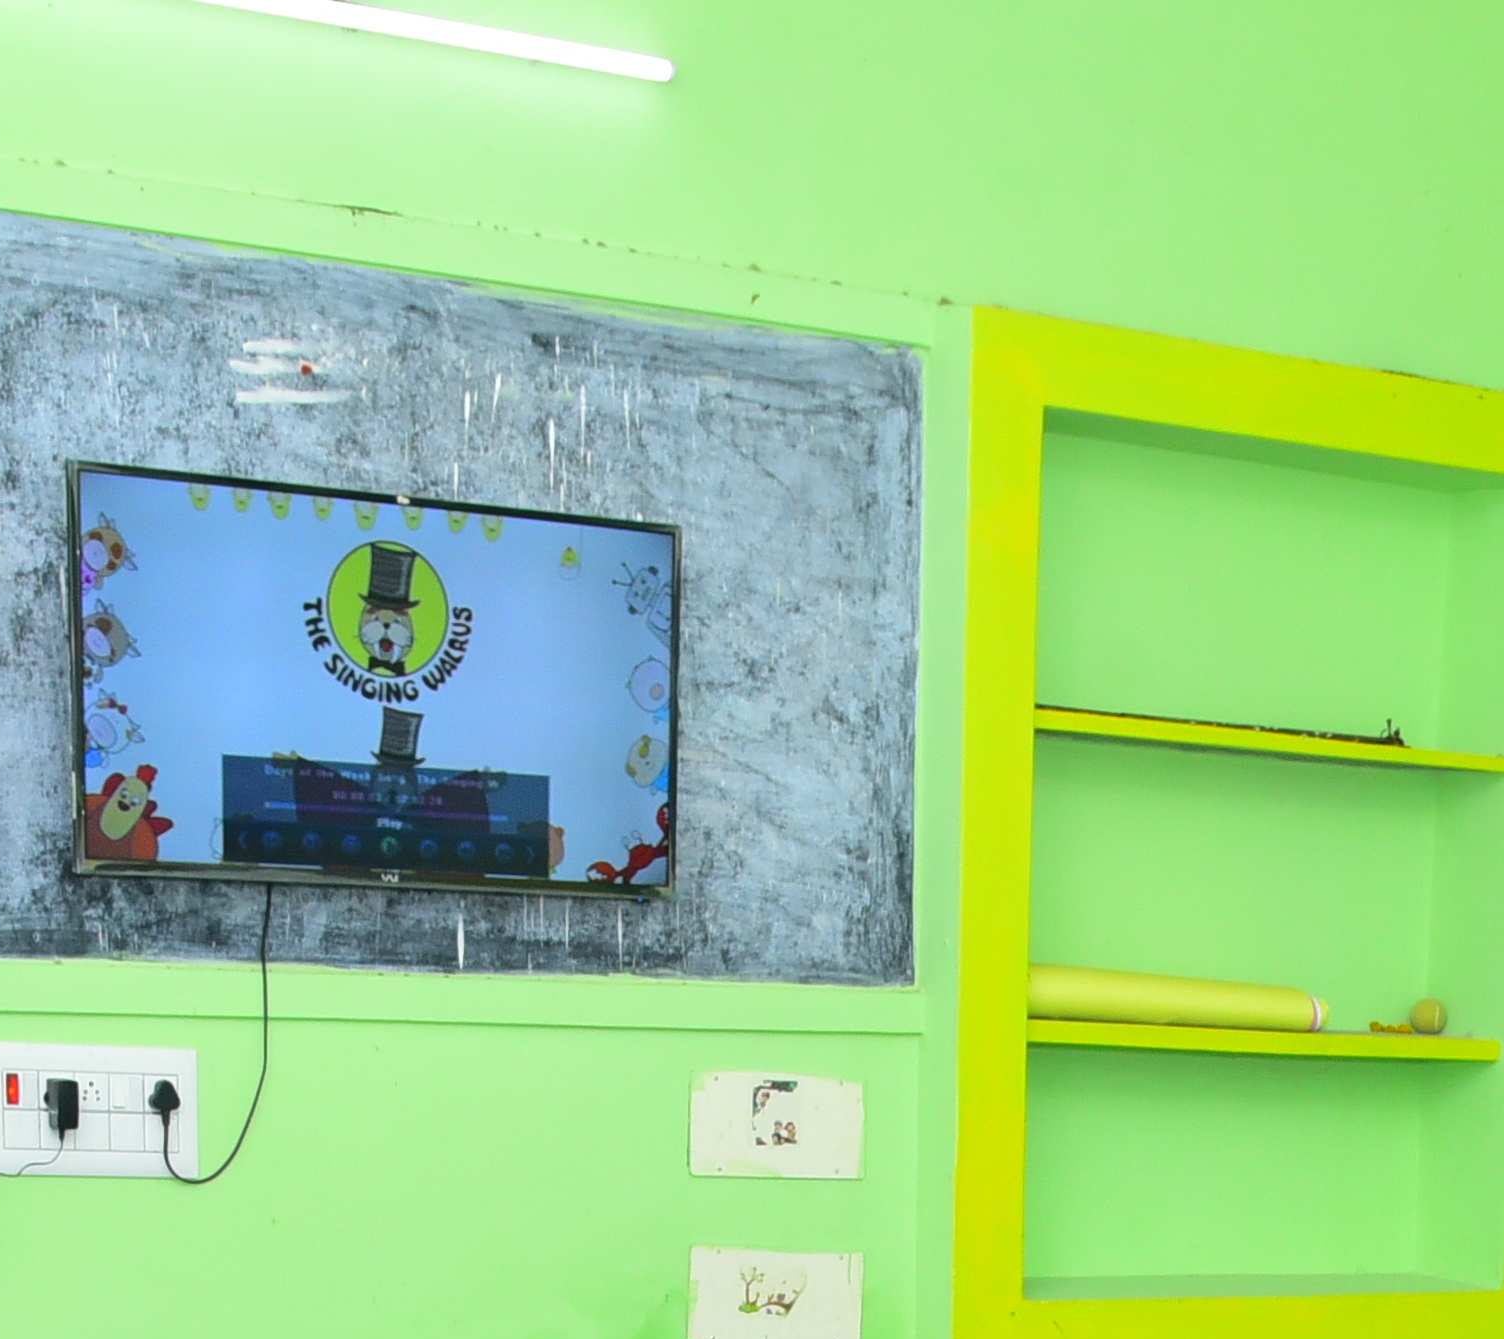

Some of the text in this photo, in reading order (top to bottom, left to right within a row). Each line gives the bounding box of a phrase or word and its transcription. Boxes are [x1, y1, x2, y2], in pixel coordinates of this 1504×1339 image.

[303, 597, 474, 704] THE SINGING WALRUS
